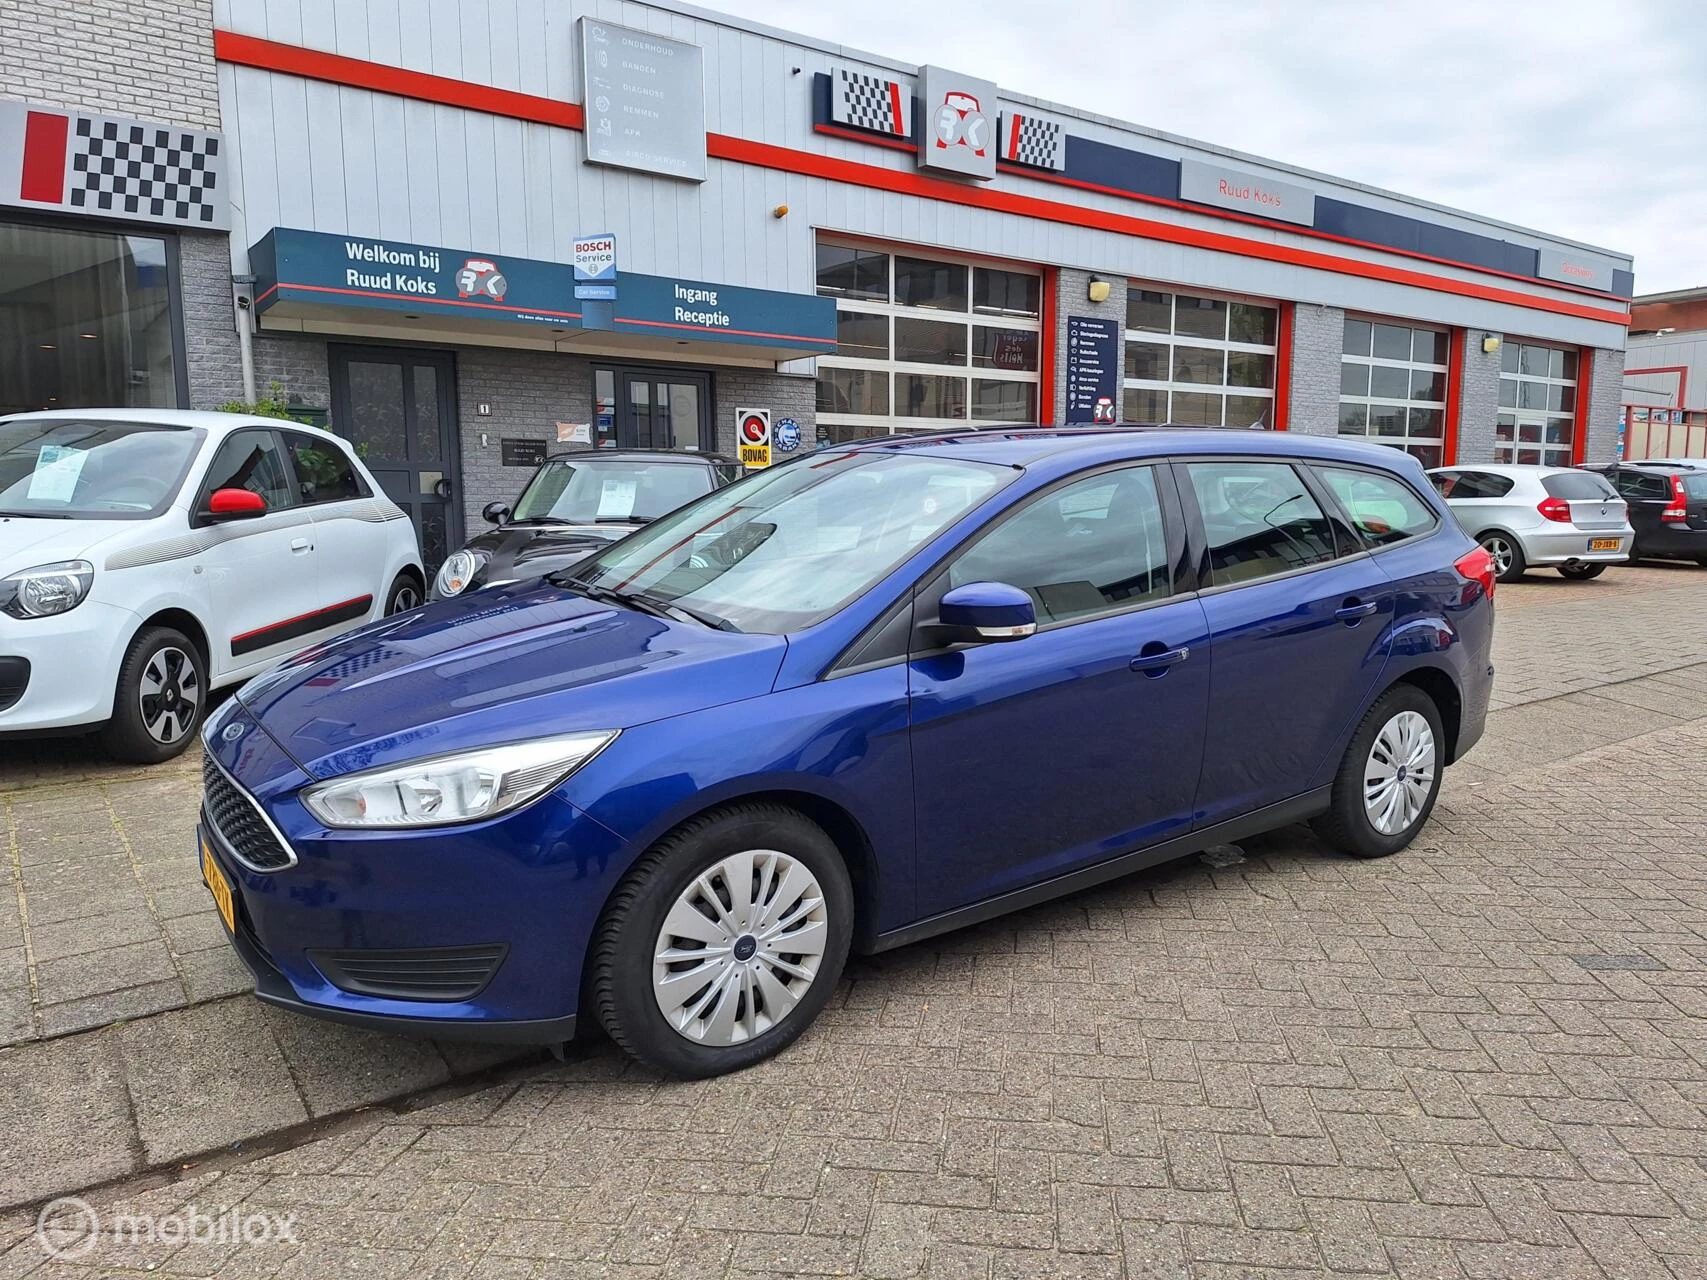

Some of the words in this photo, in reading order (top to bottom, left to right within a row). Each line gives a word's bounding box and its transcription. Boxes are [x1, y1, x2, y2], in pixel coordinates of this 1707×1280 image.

[621, 37, 674, 57] ONDERHOUD
[622, 60, 656, 75] BANDEN
[623, 83, 665, 99] DIAGNOSE
[623, 105, 659, 120] REMMEN
[624, 127, 641, 137] APK
[1219, 179, 1249, 200] Ruud
[1254, 187, 1281, 207] Koks
[575, 240, 611, 253] BOSCH
[345, 241, 416, 267] Welkom
[419, 250, 440, 273] bij
[576, 253, 612, 263] Service
[346, 268, 392, 290] Ruud
[395, 276, 437, 295] Koks
[674, 283, 718, 306] Ingang
[674, 306, 730, 327] Receptie
[742, 448, 767, 462] BOVAG
